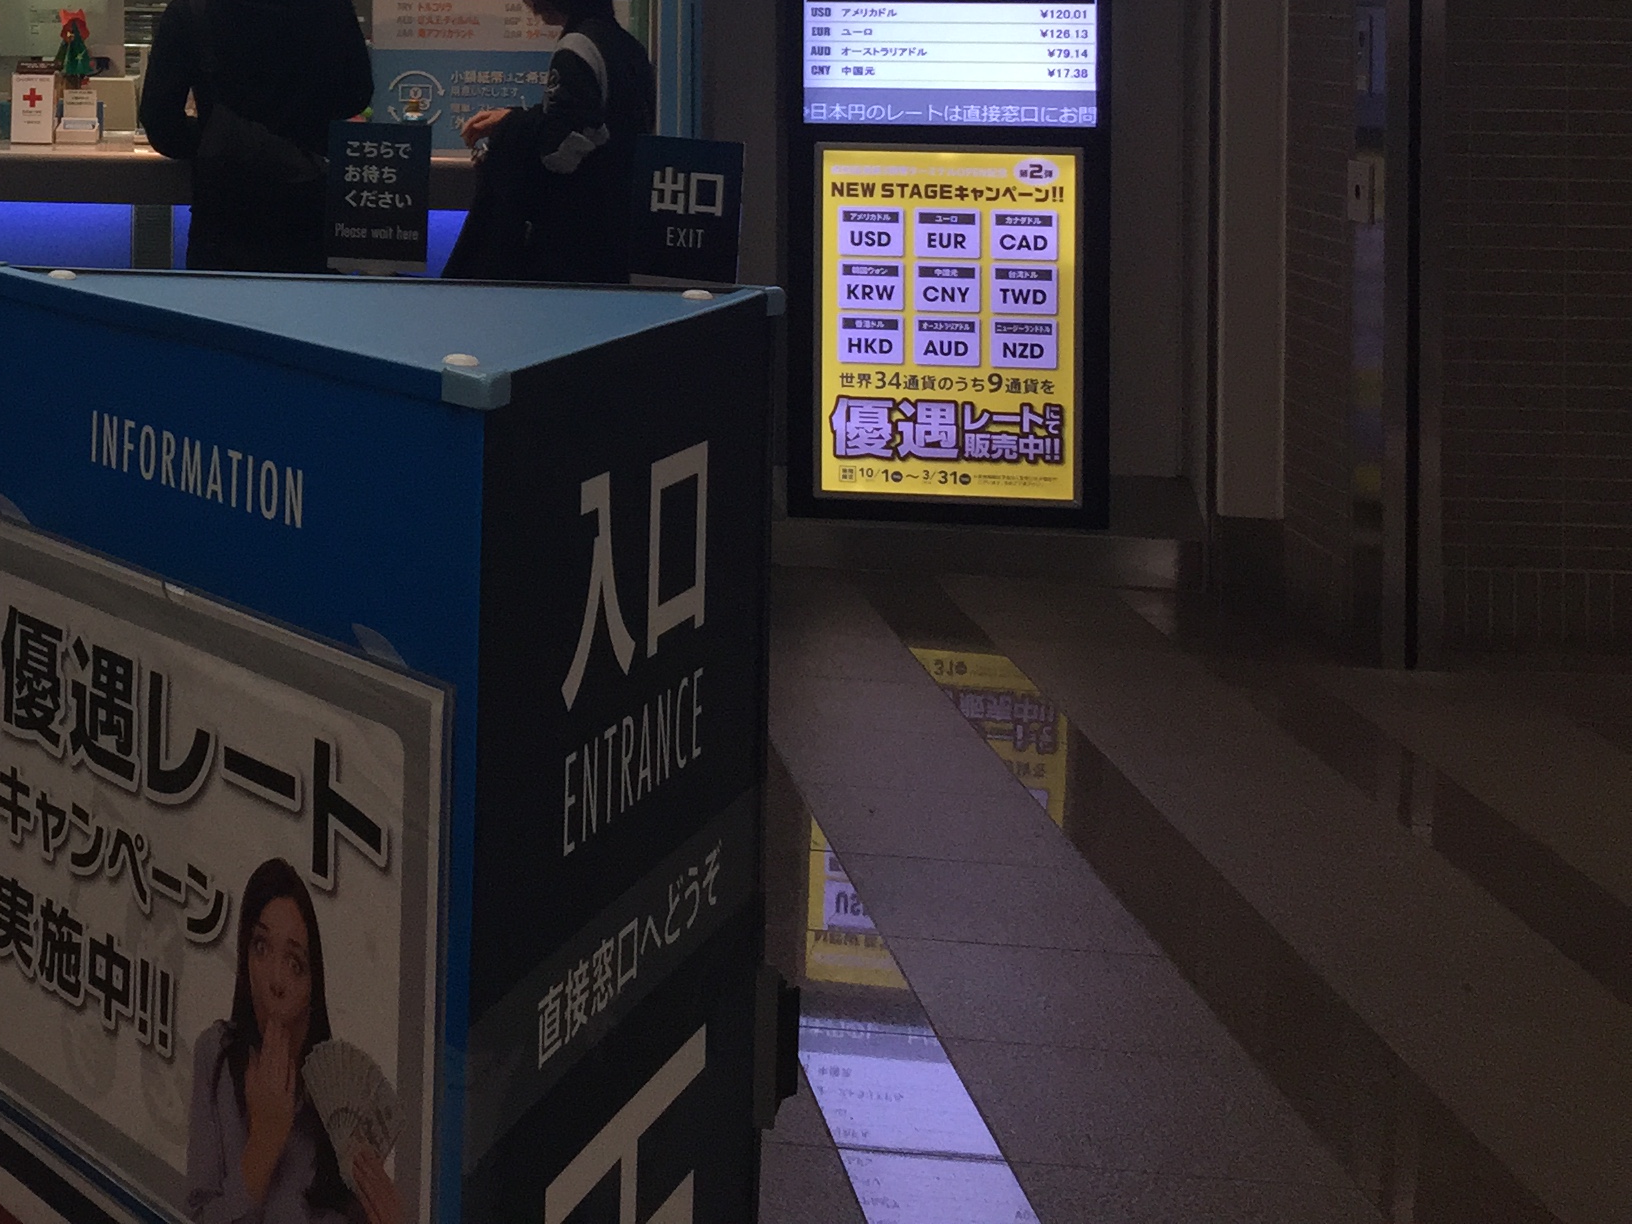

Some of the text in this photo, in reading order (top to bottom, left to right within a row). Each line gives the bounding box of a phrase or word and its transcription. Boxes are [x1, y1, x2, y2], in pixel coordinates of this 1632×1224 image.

[842, 8, 897, 18] アメリカドル
[1040, 9, 1088, 19] ¥120.01
[842, 27, 873, 37] ユーロ
[1040, 29, 1088, 39] ¥126.13
[842, 46, 927, 56] オーストラリアドル
[1047, 48, 1088, 58] ¥79.14
[842, 66, 875, 76] 中国元
[1047, 68, 1088, 78] ¥17.38
[346, 140, 412, 160] こちらで
[344, 164, 397, 185] お待ち
[344, 189, 412, 210] ください
[649, 166, 724, 217] 出口
[831, 182, 876, 198] NEW
[935, 215, 958, 223] ユーロ
[334, 222, 419, 241] Please wait here
[666, 227, 705, 249] EXIT
[849, 231, 1048, 251] USD EUR CAD
[846, 284, 1047, 305] KRW CNY TWD
[847, 338, 1045, 359] HKD AUD NZD
[839, 371, 1055, 394] 世界34通貨のうち9通貨を
[832, 396, 960, 459] 優遇
[90, 410, 304, 529] INFORMATION
[560, 440, 709, 713] 入口
[1, 604, 383, 880] 優遇レート
[562, 667, 705, 859] ENTRANCE
[537, 840, 722, 1071] 直接窓口へどうぞ
